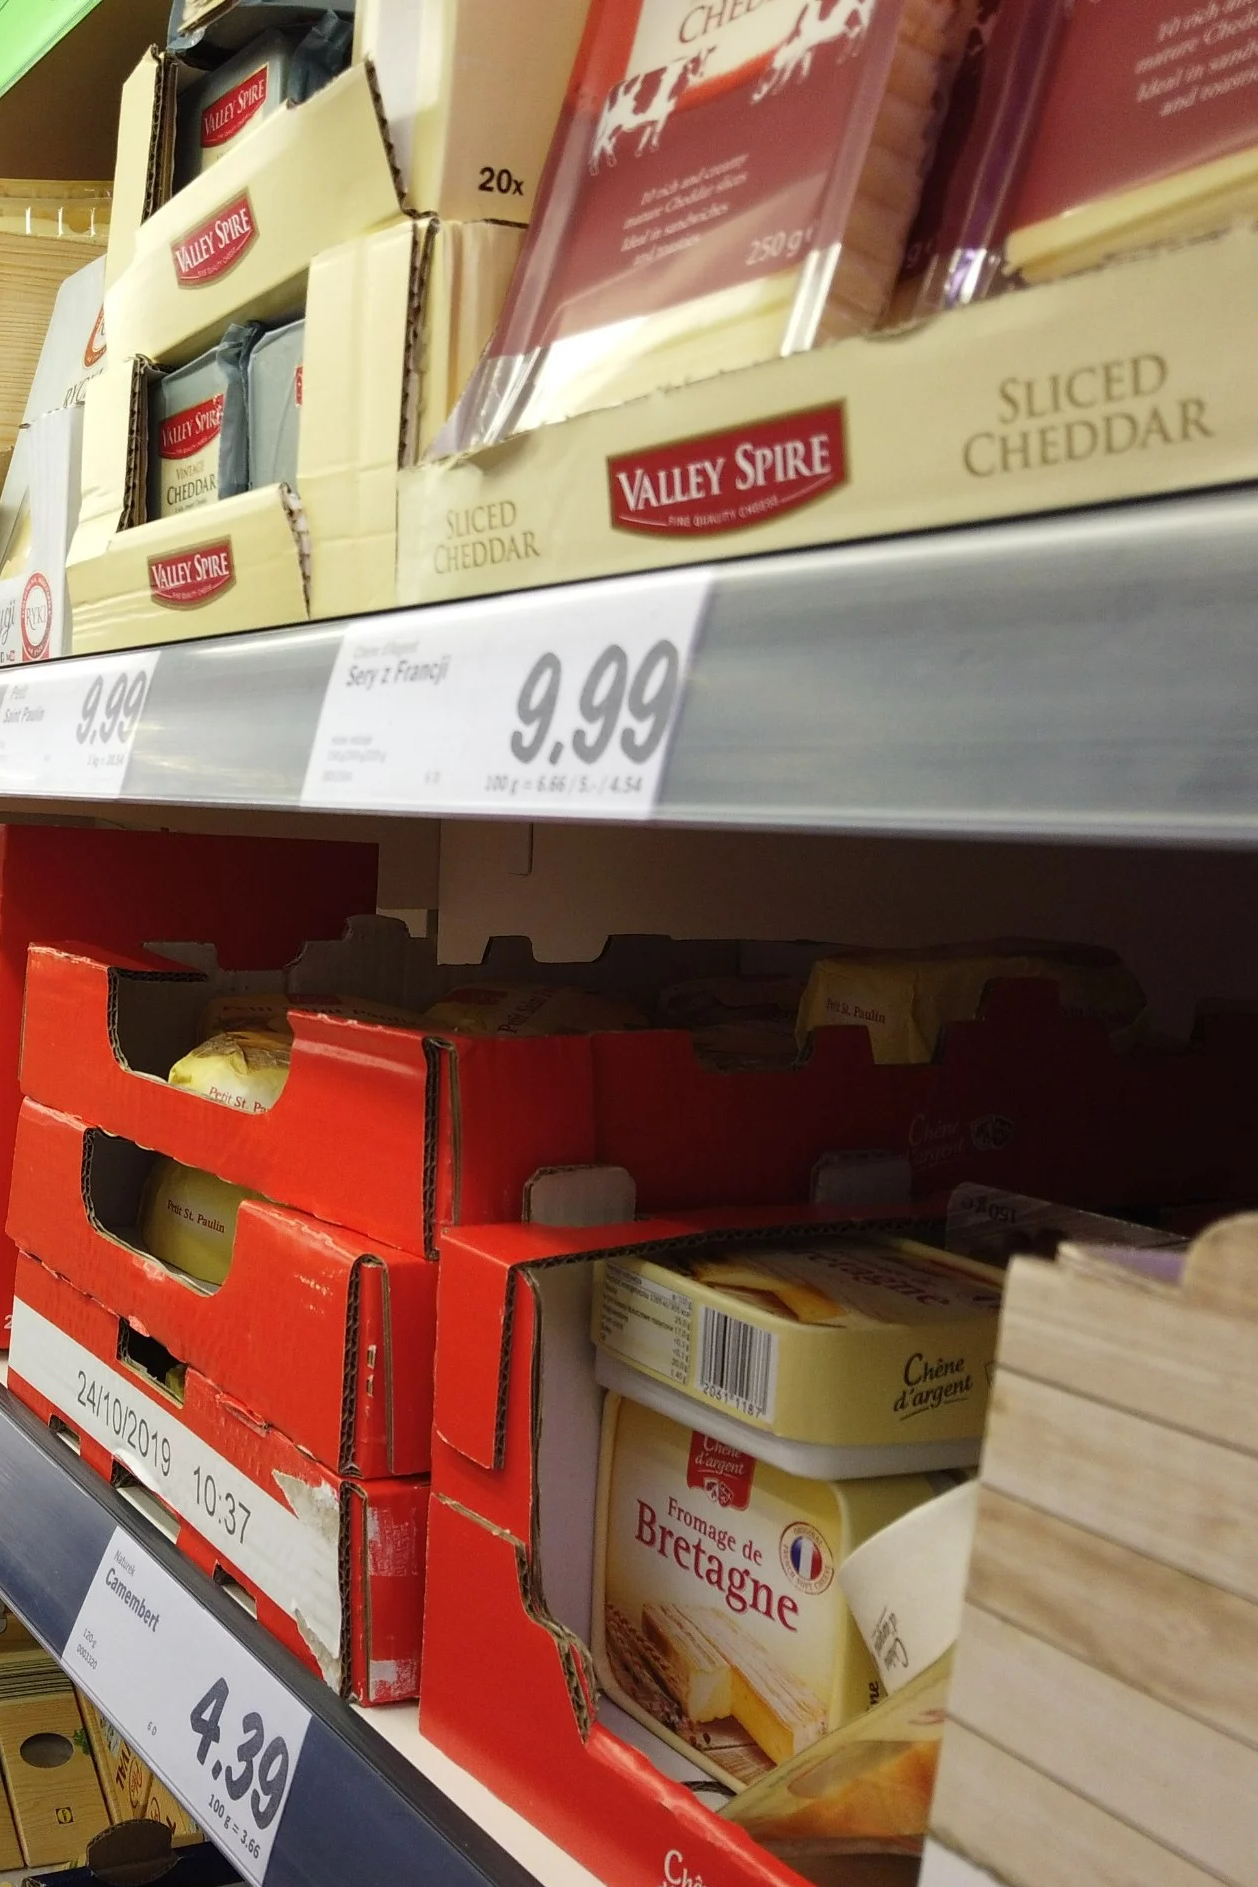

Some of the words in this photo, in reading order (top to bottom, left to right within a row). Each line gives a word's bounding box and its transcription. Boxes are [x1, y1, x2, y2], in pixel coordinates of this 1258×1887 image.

[203, 100, 235, 136] VALLEY
[237, 78, 265, 115] SPIRE
[478, 166, 525, 196] 20x
[175, 230, 214, 273] VALLEY
[214, 207, 251, 250] SPIRE
[998, 353, 1167, 424] SLICED
[163, 419, 193, 447] VALLEY
[962, 398, 1214, 479] CHEDDAR
[167, 473, 217, 506] CHEDDAR
[616, 456, 725, 513] VALLEY
[733, 433, 832, 491] SPIRE
[447, 499, 517, 541] SLICED
[152, 561, 192, 590] VALLEY
[194, 552, 229, 582] SPIRE
[434, 529, 541, 575] CHEDDAR
[346, 661, 378, 691] Sery
[380, 665, 391, 683] z
[394, 653, 452, 689] Francji
[76, 670, 147, 745] 9.99
[510, 638, 680, 765] 9.99
[208, 1085, 233, 1107] Petit
[167, 1199, 184, 1219] Petit
[184, 1206, 195, 1224] St.
[197, 1213, 226, 1235] Paulin
[893, 1373, 974, 1413] d'argent
[903, 1351, 966, 1389] Chêne
[77, 1369, 172, 1479] 24/10/2019
[193, 1465, 252, 1544] 10:37
[694, 1450, 746, 1476] d'argent
[668, 1496, 737, 1554] Fromage
[634, 1499, 800, 1633] Bretagne
[741, 1534, 763, 1567] de
[105, 1567, 161, 1633] Camembert
[76, 1643, 98, 1671] 0003320
[188, 1675, 291, 1832] 4.39
[208, 1793, 226, 1818] 100
[223, 1816, 231, 1830] g
[240, 1830, 261, 1860] 3.66
